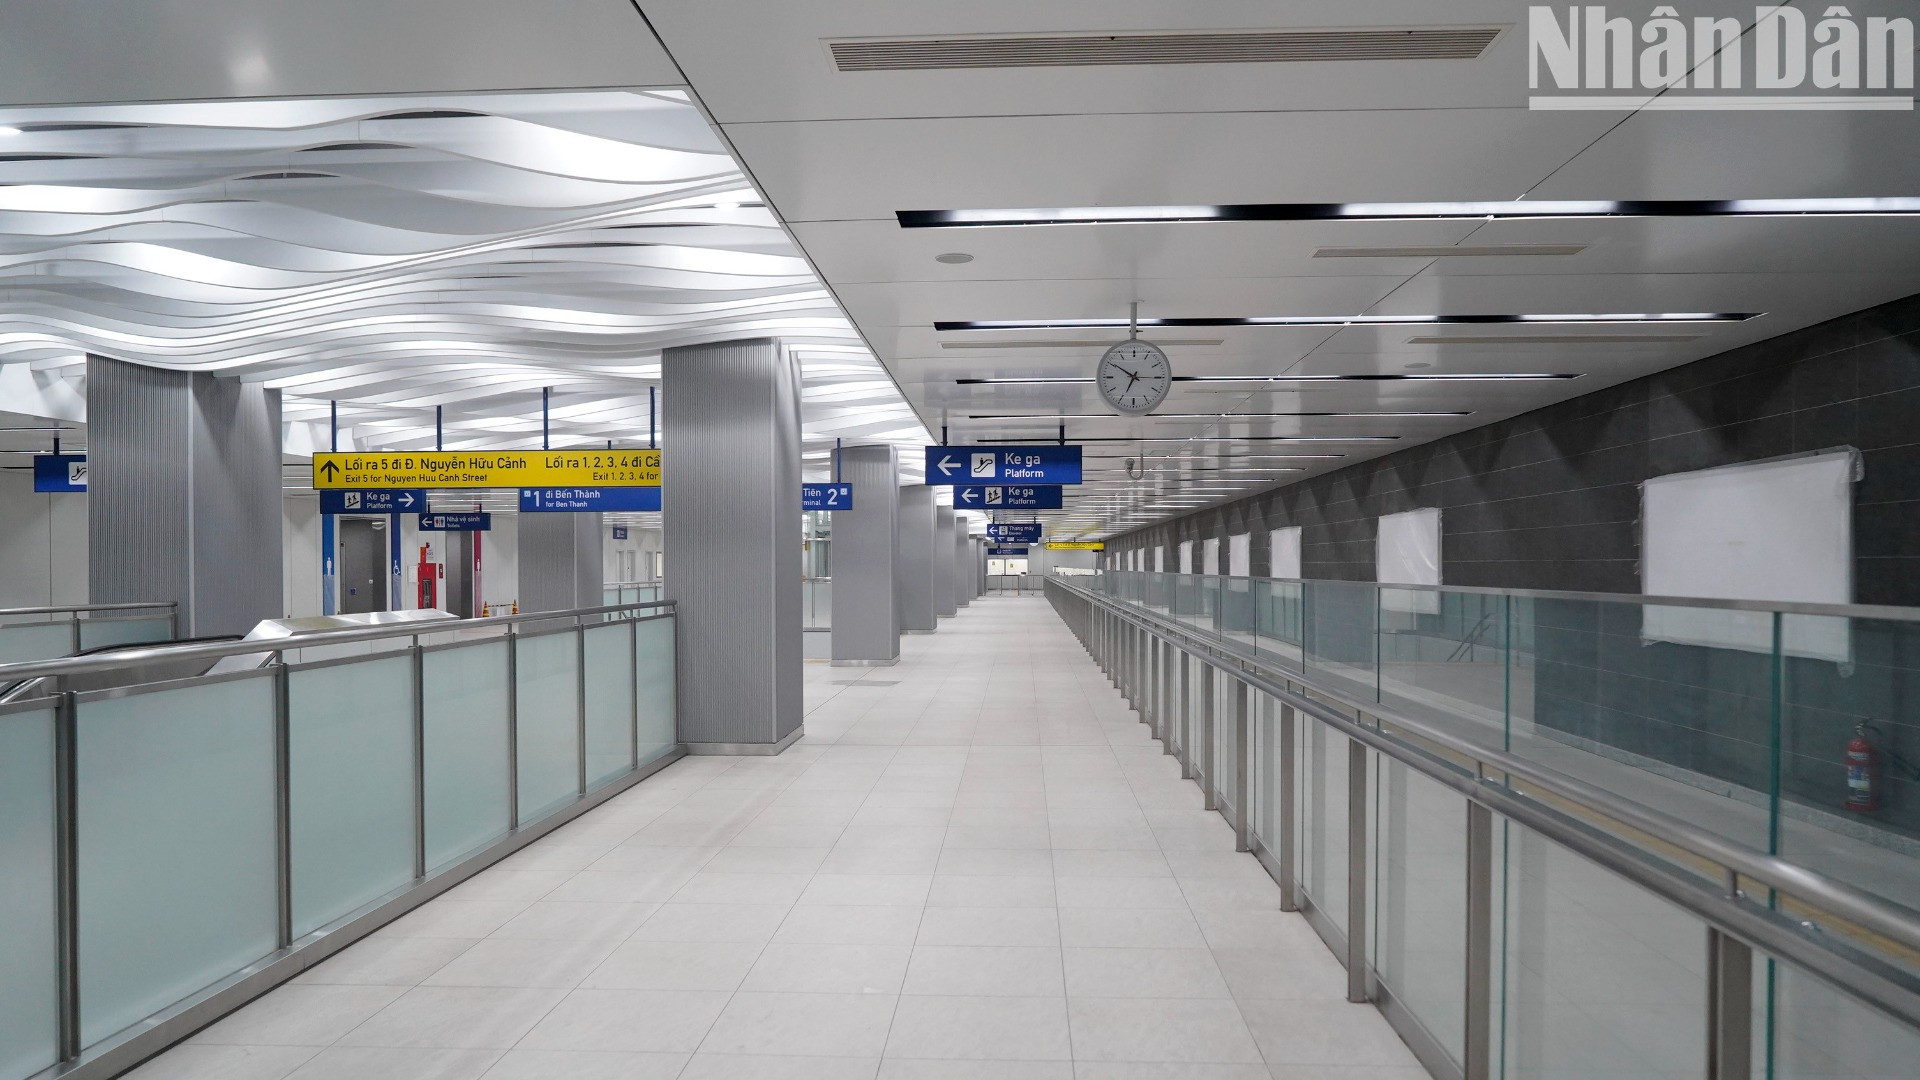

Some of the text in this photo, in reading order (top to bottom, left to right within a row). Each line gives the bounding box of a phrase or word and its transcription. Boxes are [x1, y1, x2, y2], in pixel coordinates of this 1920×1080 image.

[345, 456, 527, 472] Lối ra 5 đi Đ. Nguyễn Hữu Cảnh
[545, 455, 563, 468] Lối
[566, 459, 579, 468] ra
[620, 456, 628, 468] 4
[631, 456, 642, 468] đi
[645, 454, 661, 468] Cầ
[1005, 453, 1041, 467] Ke ga
[345, 473, 488, 485] Exit 5 for Nguyen Huu Canh Street
[593, 472, 609, 480] Exit
[639, 471, 645, 480] 4
[646, 471, 659, 480] for
[1005, 468, 1044, 478] Platform
[366, 491, 390, 502] Ke ga
[533, 488, 601, 507] 1 đi Bến Thành
[802, 487, 838, 505] Tiên 2
[1008, 486, 1034, 497] Ke ga
[1008, 497, 1036, 505] Platform
